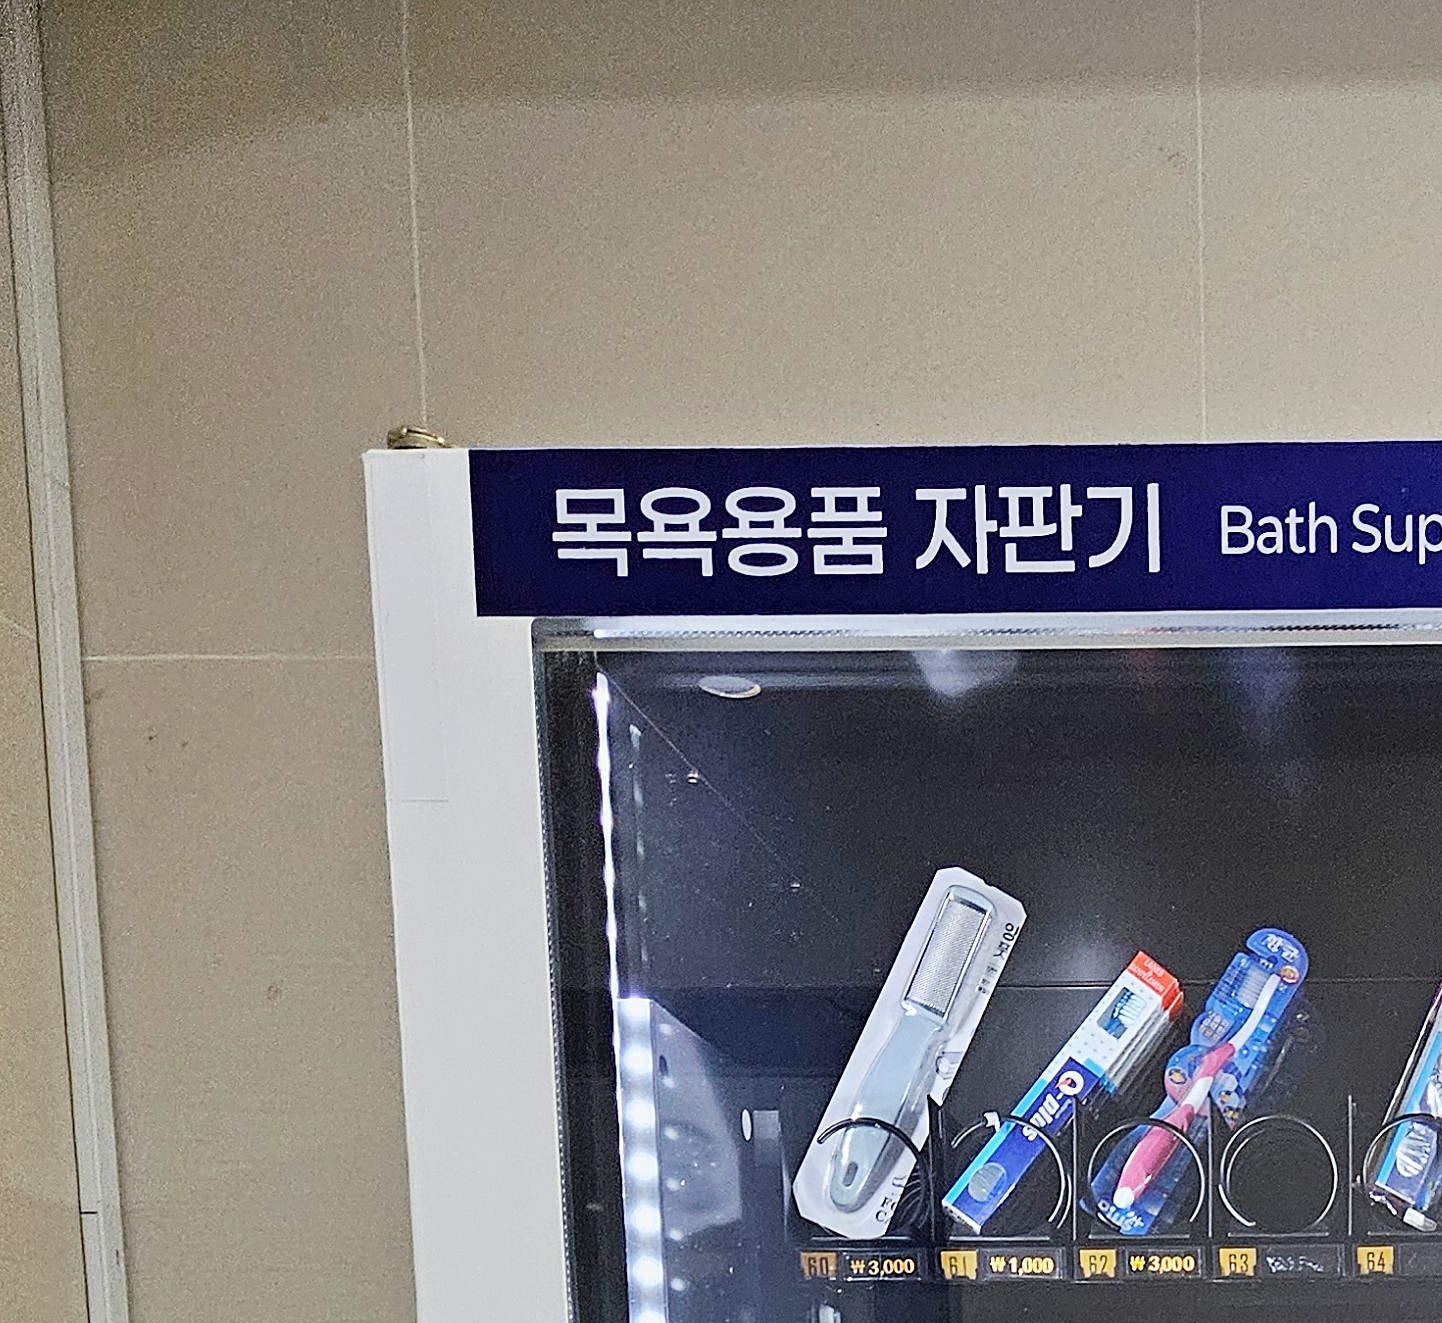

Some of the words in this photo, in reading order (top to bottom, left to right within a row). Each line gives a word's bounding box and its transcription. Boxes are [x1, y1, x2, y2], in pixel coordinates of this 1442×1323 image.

[552, 486, 888, 579] 목욕용품
[918, 484, 1165, 574] 자판기
[1220, 504, 1340, 558] Bath
[849, 1257, 915, 1276] ₩3,000
[988, 1255, 1055, 1276] ₩1,000
[1129, 1255, 1195, 1275] ₩3,000
